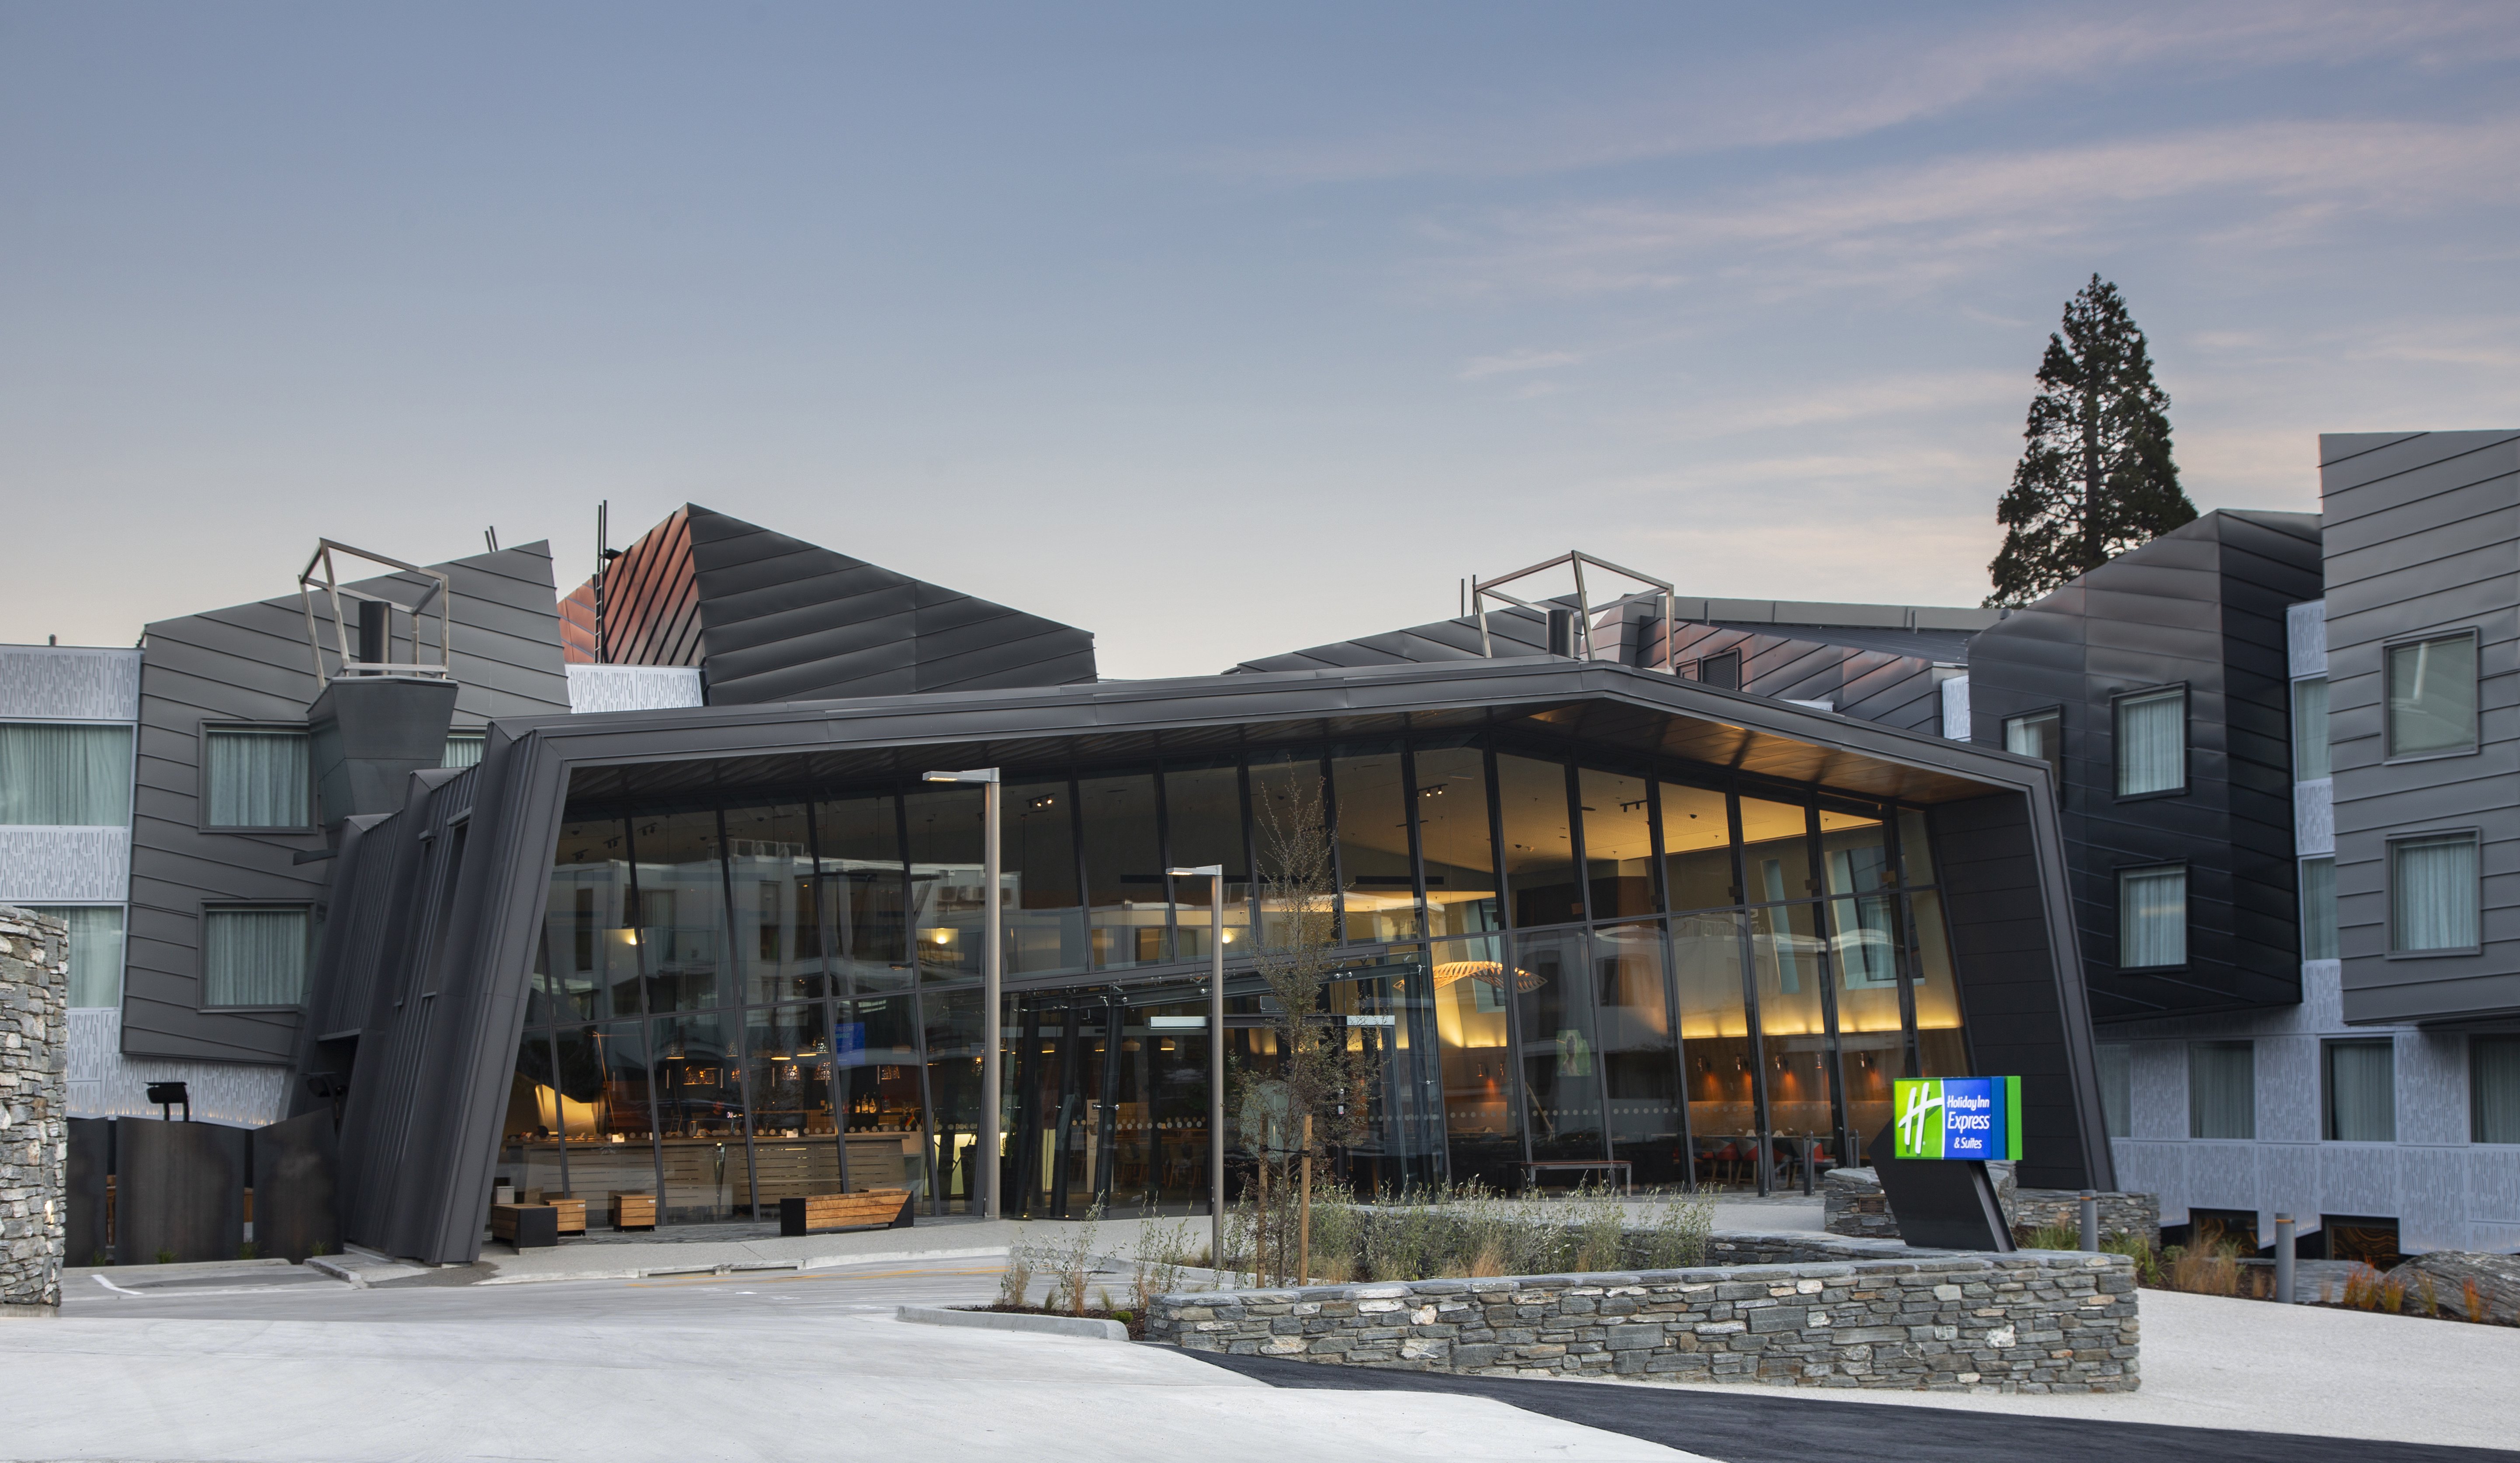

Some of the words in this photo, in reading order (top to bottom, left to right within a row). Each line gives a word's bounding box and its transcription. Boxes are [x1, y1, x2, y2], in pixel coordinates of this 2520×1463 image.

[1947, 1095, 1977, 1111] Holiday
[1977, 1095, 1990, 1108] Inn
[1948, 1112, 1990, 1134] Express
[1954, 1137, 1960, 1148] &
[1960, 1138, 1982, 1149] Suites
